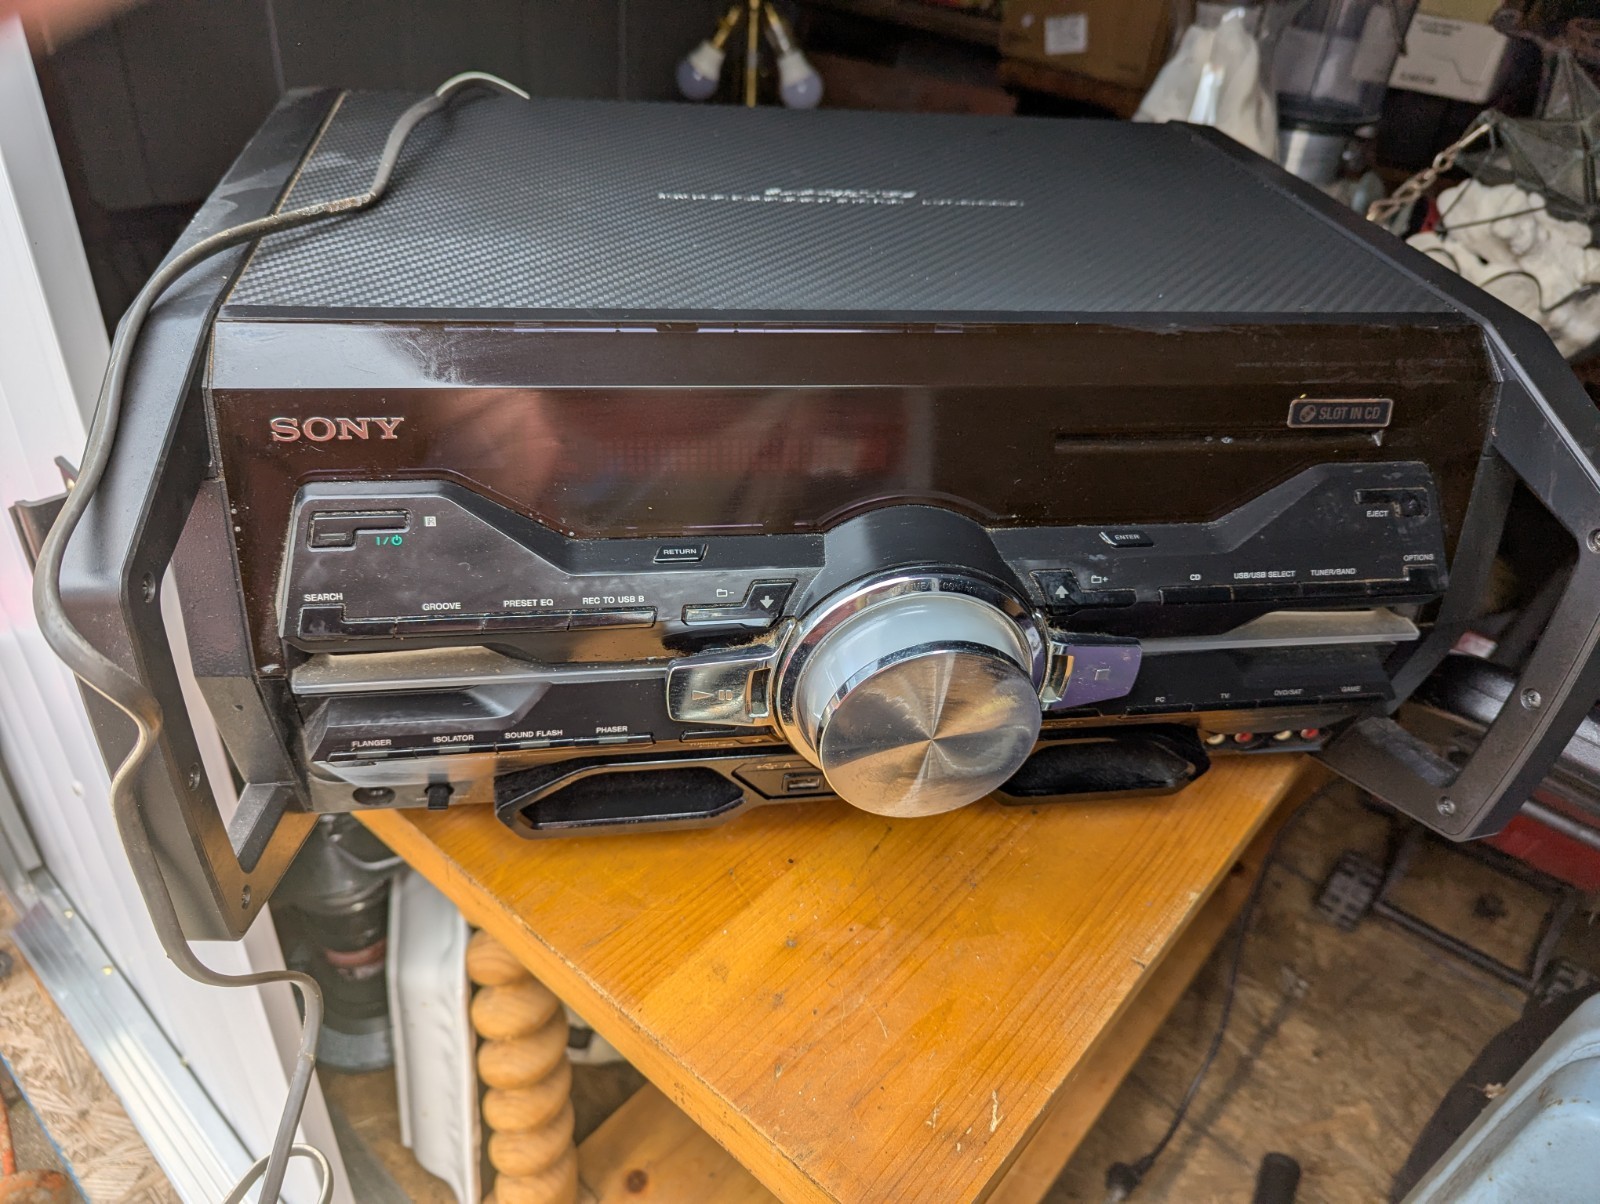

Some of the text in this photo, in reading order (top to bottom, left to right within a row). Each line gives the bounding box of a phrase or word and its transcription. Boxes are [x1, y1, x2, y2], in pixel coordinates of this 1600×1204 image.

[1318, 405, 1381, 420] SLOT IN CD
[270, 416, 405, 442] SONY
[1366, 510, 1389, 518] EJECT
[1403, 553, 1434, 562] OPTIONS
[1189, 573, 1202, 581] CD
[1233, 570, 1297, 580] USB/USB SELECT
[1310, 568, 1357, 577] TUNER/BAND
[303, 592, 344, 602] SEARCH
[582, 595, 645, 605] REC TO USB B
[421, 602, 462, 611] GROOVE
[503, 598, 554, 608] PRESET EQ
[1340, 685, 1362, 693] GAME
[504, 729, 563, 739] SOUND FLASH
[595, 725, 628, 734] PHASER
[433, 734, 475, 743] ISOLATOR
[351, 739, 392, 748] FLANGER
